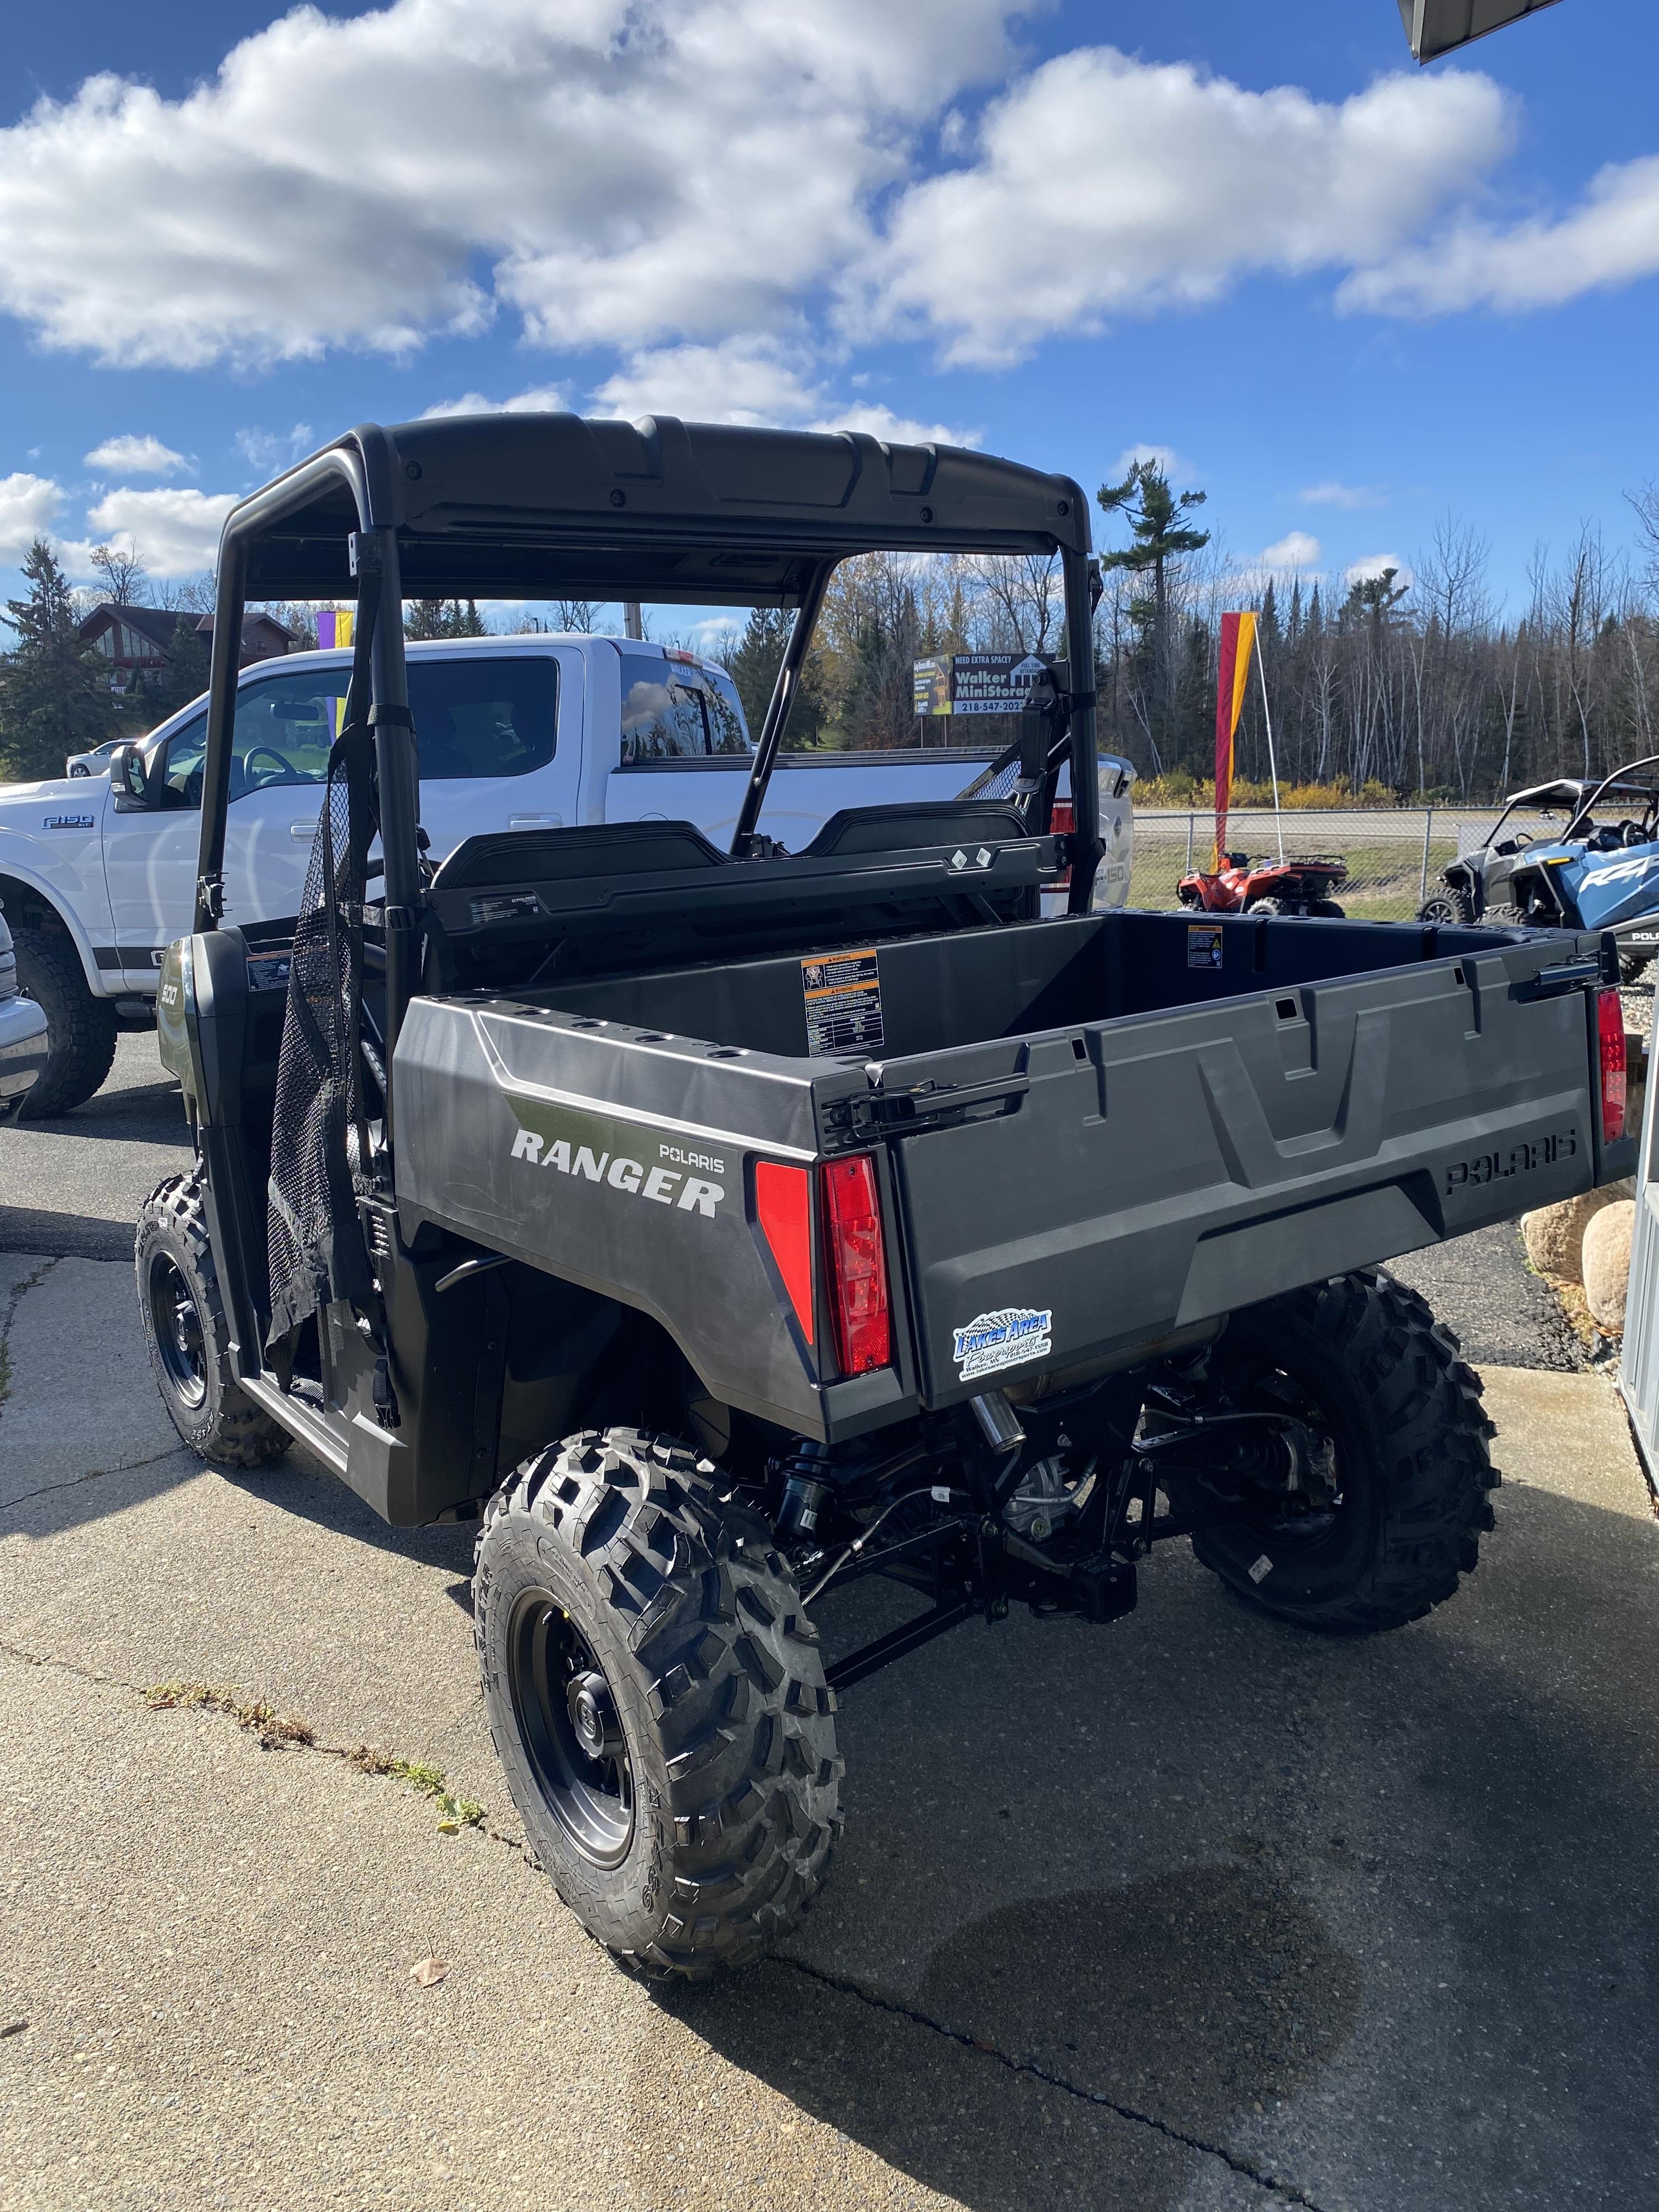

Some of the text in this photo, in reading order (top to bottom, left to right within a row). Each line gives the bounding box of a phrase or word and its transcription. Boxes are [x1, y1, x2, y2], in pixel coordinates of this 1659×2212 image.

[670, 663, 692, 679] WALKER
[972, 656, 990, 664] EXTRA
[991, 656, 1011, 664] SPACE?
[955, 671, 1007, 684] Walker
[956, 685, 1030, 698] MiniStorag
[962, 702, 1023, 712] 218-547-202
[659, 1143, 725, 1175] POLARIS
[1446, 1128, 1576, 1197] POLARIS
[510, 1128, 725, 1218] RANGER
[956, 1313, 1048, 1359] LAKES AREA
[962, 1347, 1048, 1379] www.lakesareapowersports.com
[966, 1335, 1040, 1367] Powersports
[966, 1362, 989, 1372] Walker,
